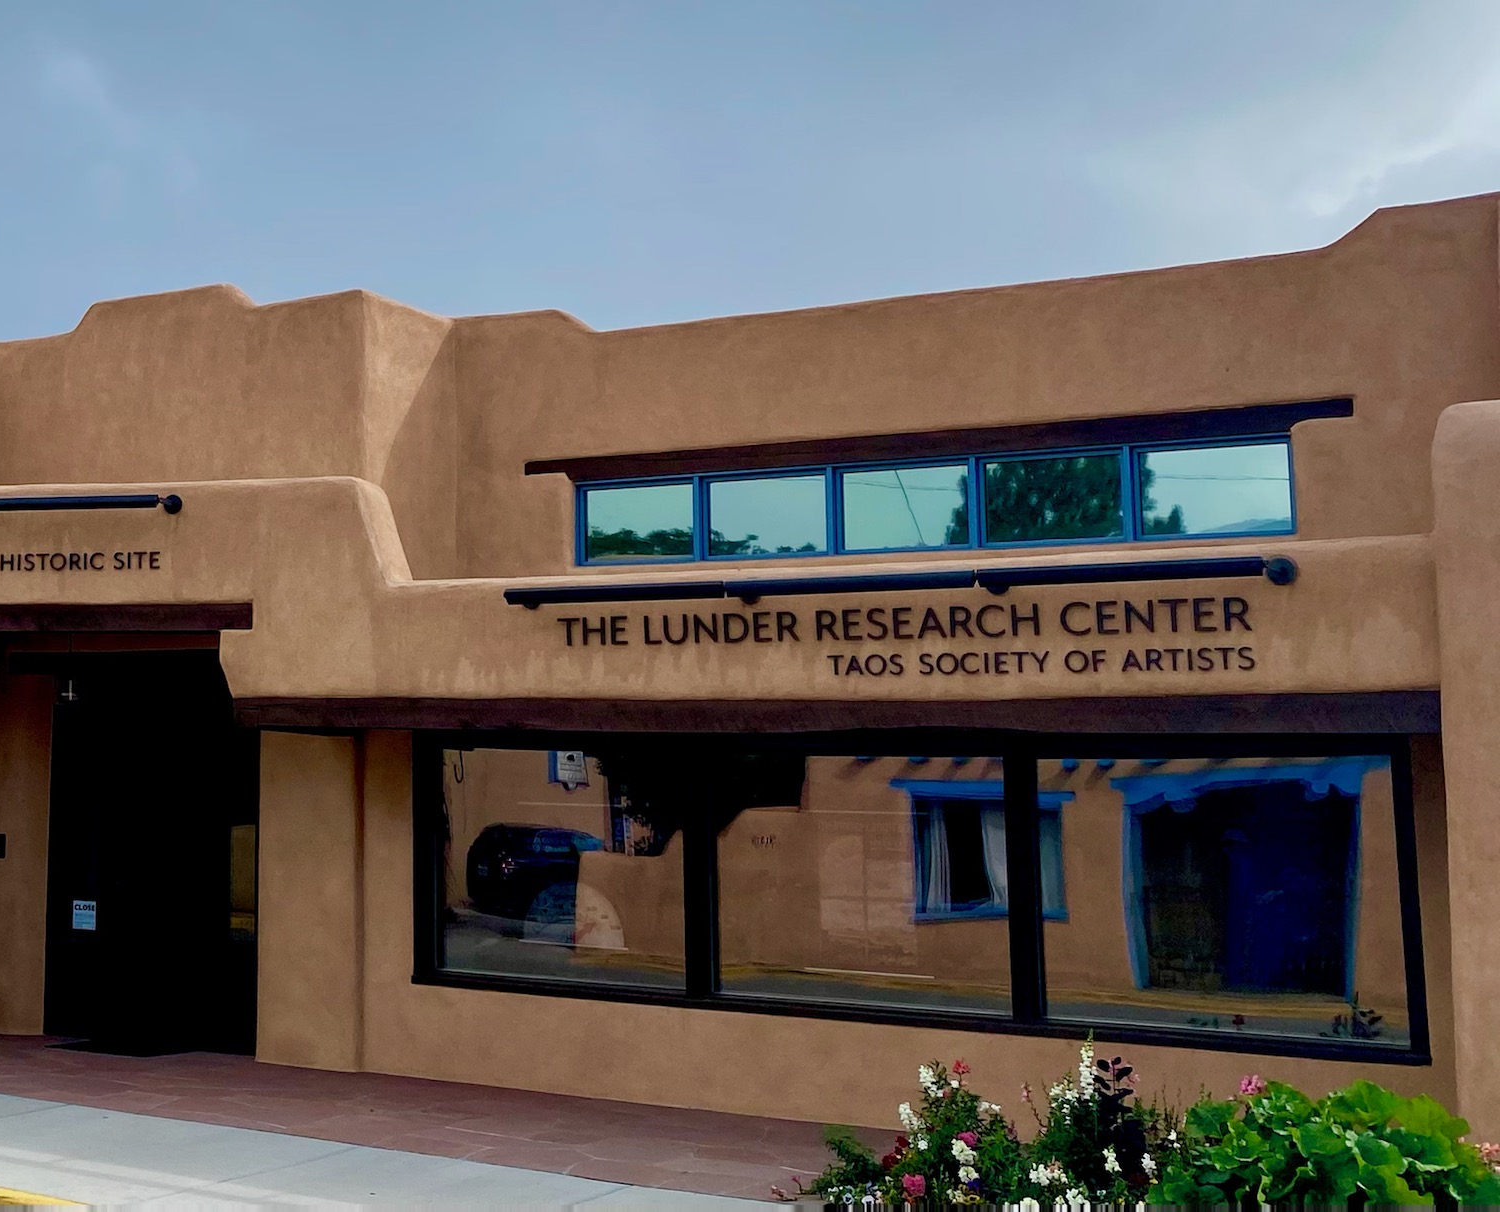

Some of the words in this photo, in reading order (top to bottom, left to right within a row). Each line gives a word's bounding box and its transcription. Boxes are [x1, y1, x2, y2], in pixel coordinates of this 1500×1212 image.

[0, 552, 104, 572] HISTORIC
[113, 551, 161, 570] SITE
[557, 616, 628, 646] THE
[643, 611, 800, 645] LUNDER
[815, 603, 1040, 641] RESEARCH
[1059, 597, 1253, 636] CENTER
[827, 654, 904, 676] TAOS
[919, 651, 1049, 675] SOCIETY
[1064, 650, 1106, 673] OF
[1122, 647, 1255, 672] ARTISTS
